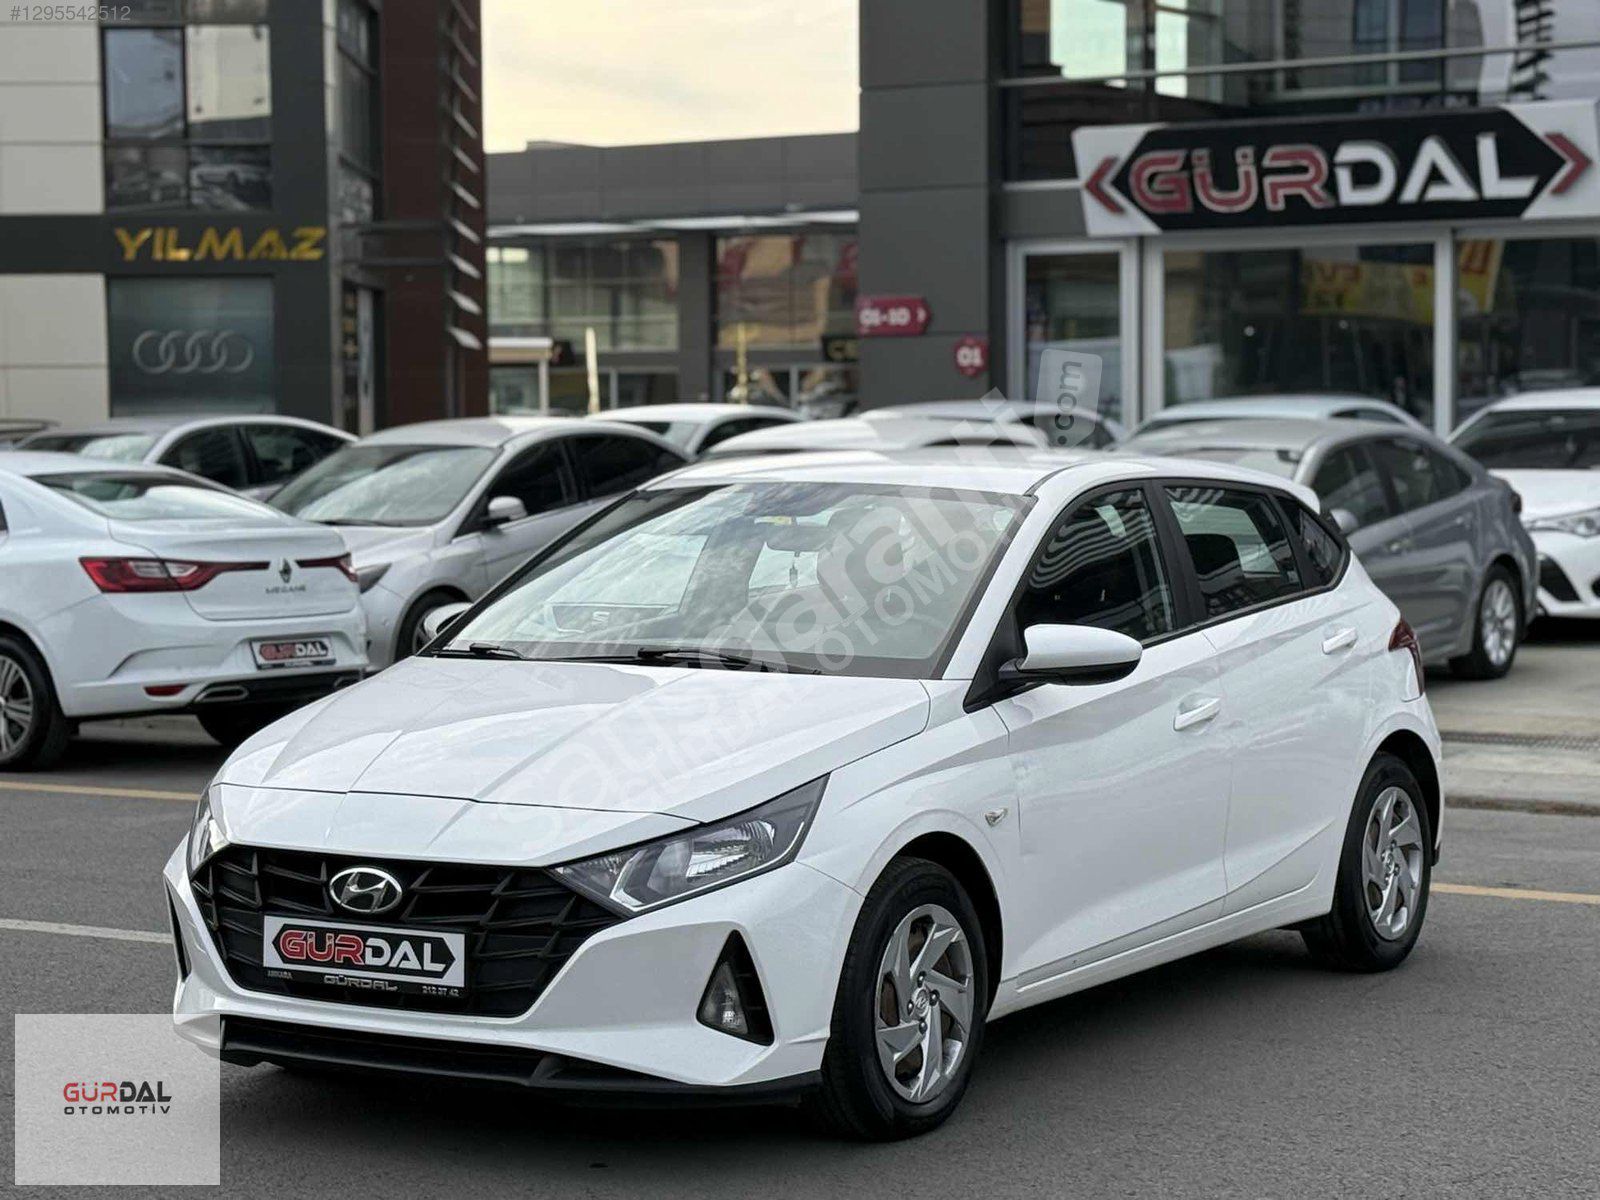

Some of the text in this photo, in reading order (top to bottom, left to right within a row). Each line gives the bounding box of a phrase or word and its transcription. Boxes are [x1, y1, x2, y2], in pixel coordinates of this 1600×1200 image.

[1129, 133, 1539, 214] GÜRDAL
[114, 226, 327, 262] YILMAZ
[280, 929, 446, 972] GÜRDAL
